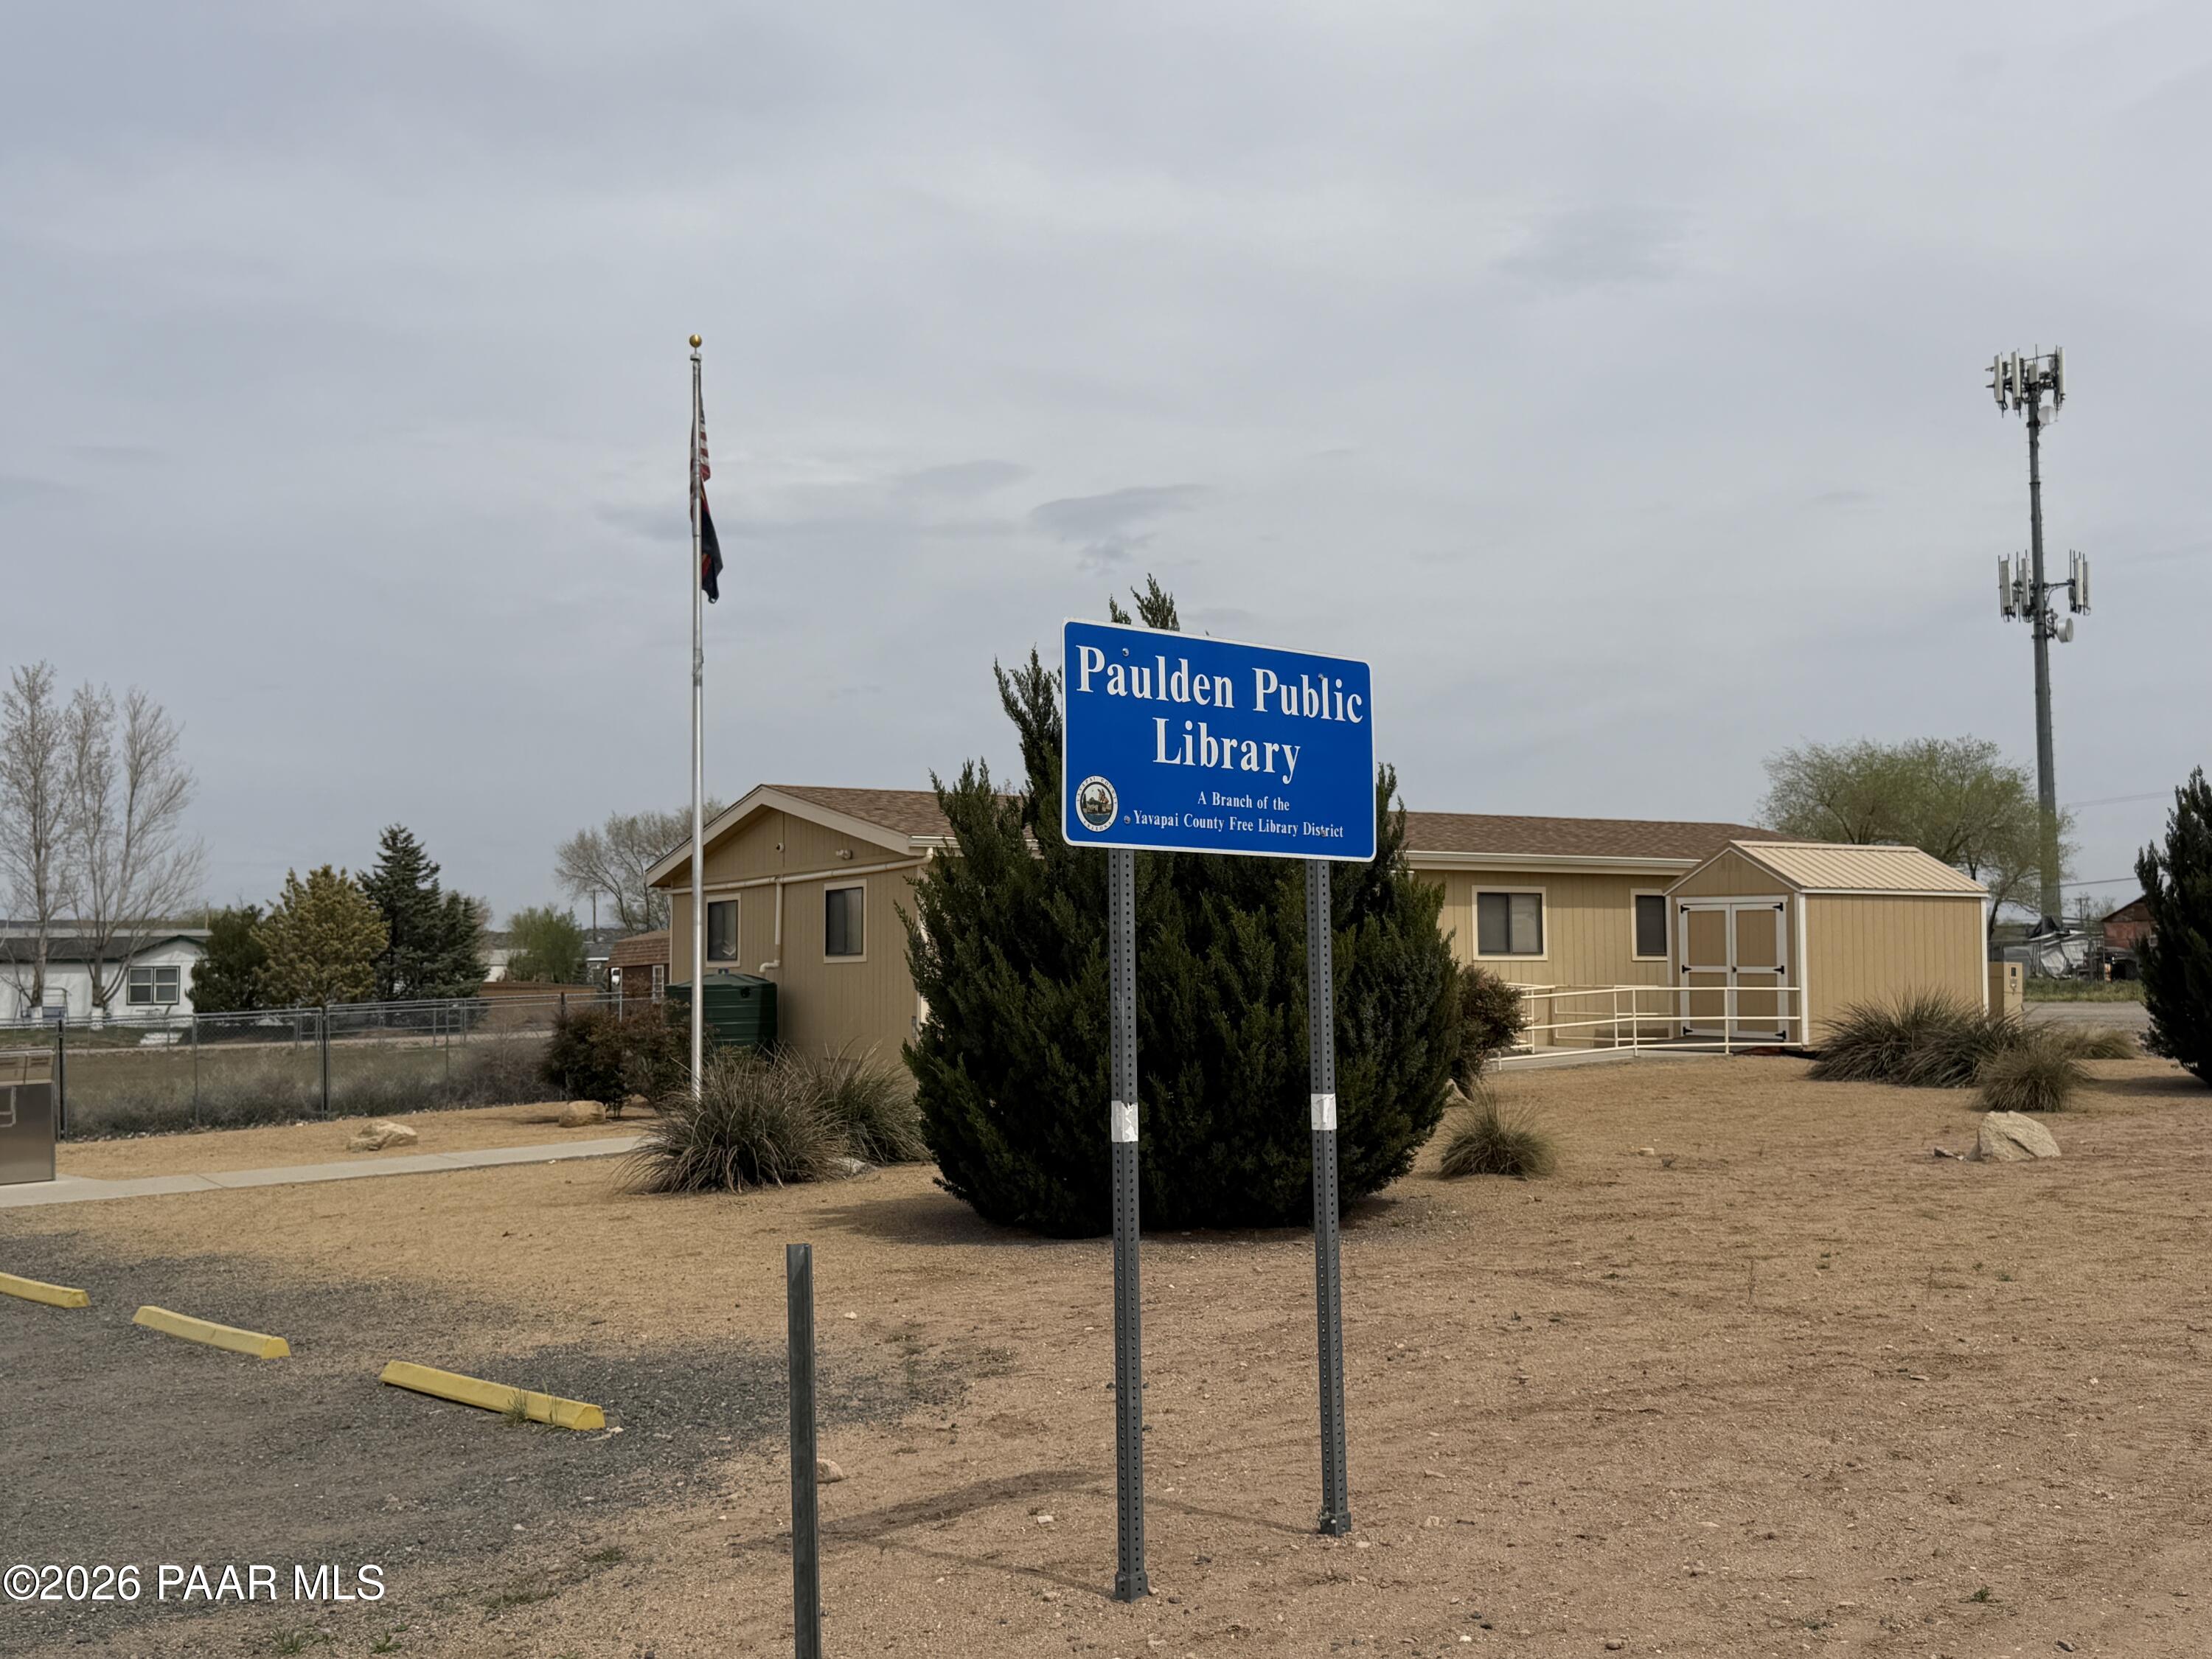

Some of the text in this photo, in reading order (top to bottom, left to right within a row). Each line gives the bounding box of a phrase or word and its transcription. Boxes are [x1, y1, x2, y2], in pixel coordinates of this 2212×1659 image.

[1076, 644, 1364, 724] Paulden Public
[1152, 717, 1301, 785] Library
[1133, 810, 1343, 838] Yavapai County Free Library District
[1197, 791, 1290, 811] A Branch of the
